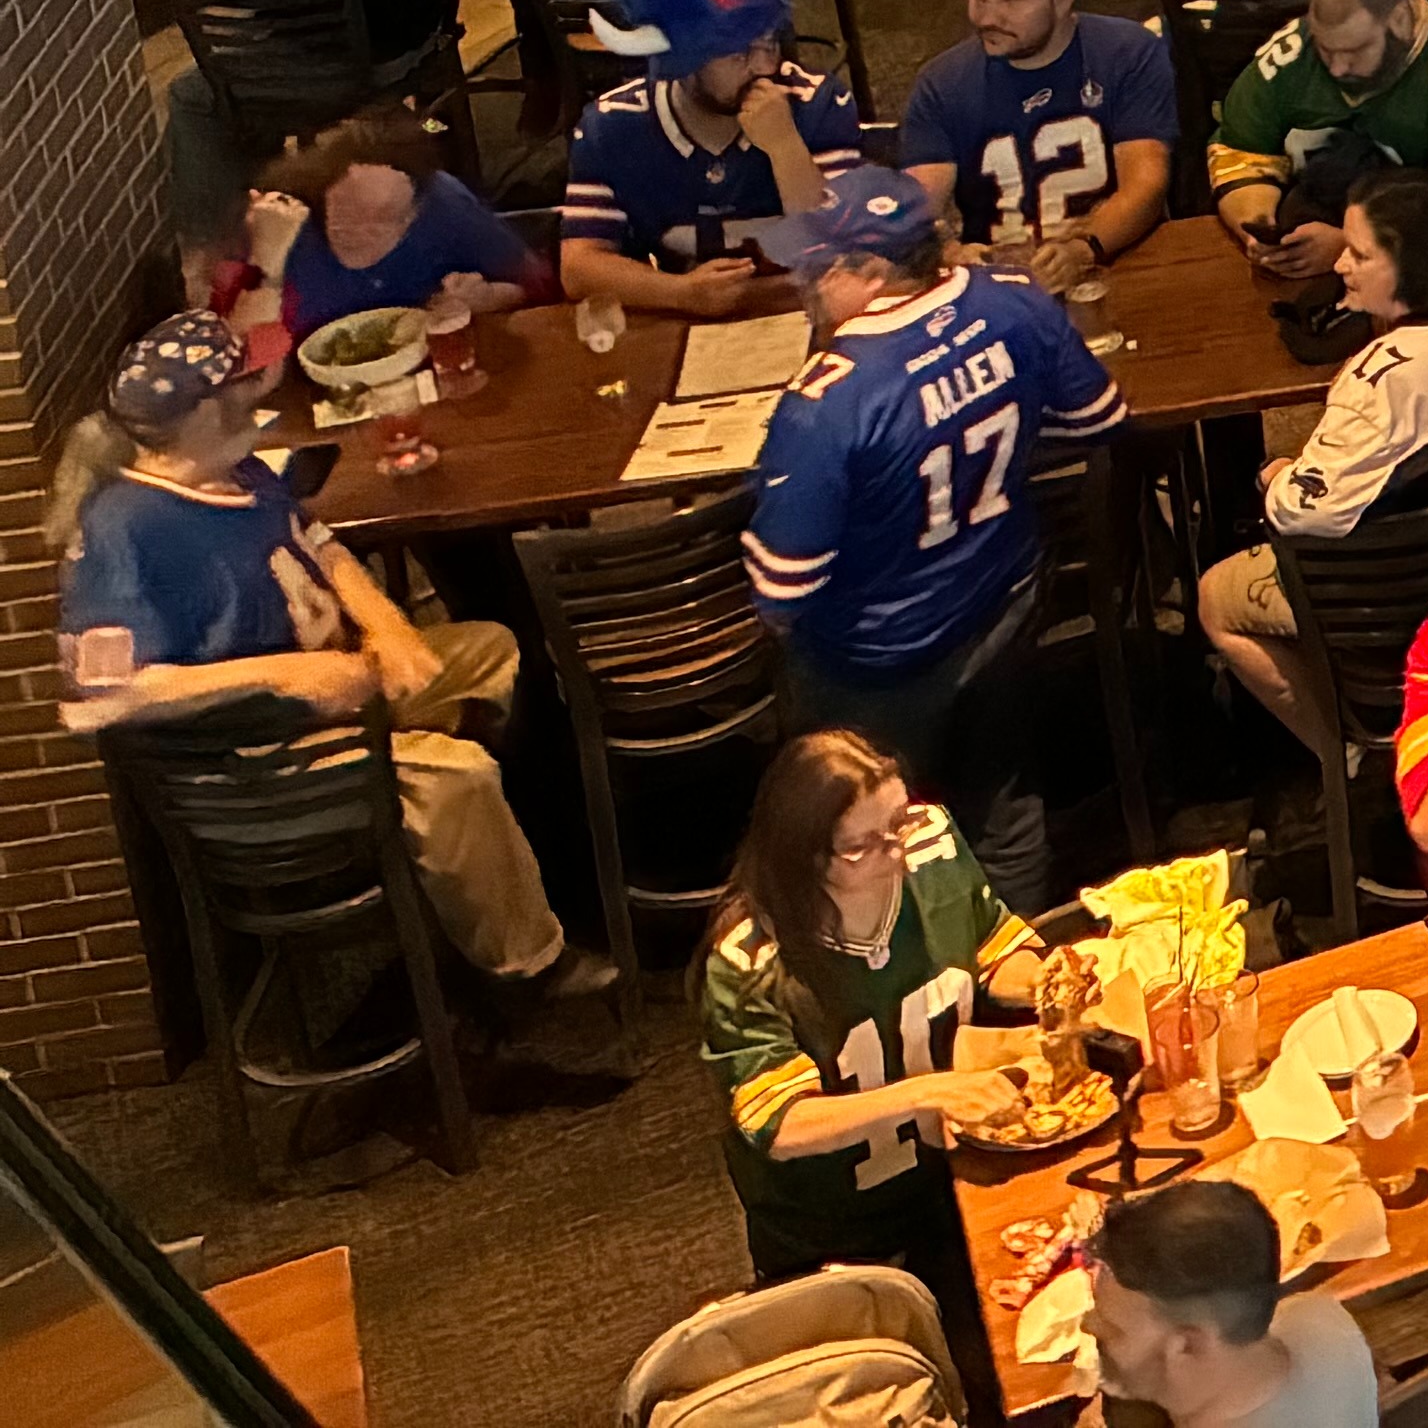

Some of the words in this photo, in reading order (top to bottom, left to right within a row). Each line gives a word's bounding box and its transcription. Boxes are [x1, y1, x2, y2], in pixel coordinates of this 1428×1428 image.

[981, 114, 1109, 242] 12
[786, 351, 857, 401] 17
[918, 340, 1016, 430] ALLEN
[1351, 341, 1414, 390] 17
[917, 400, 1021, 551] 17
